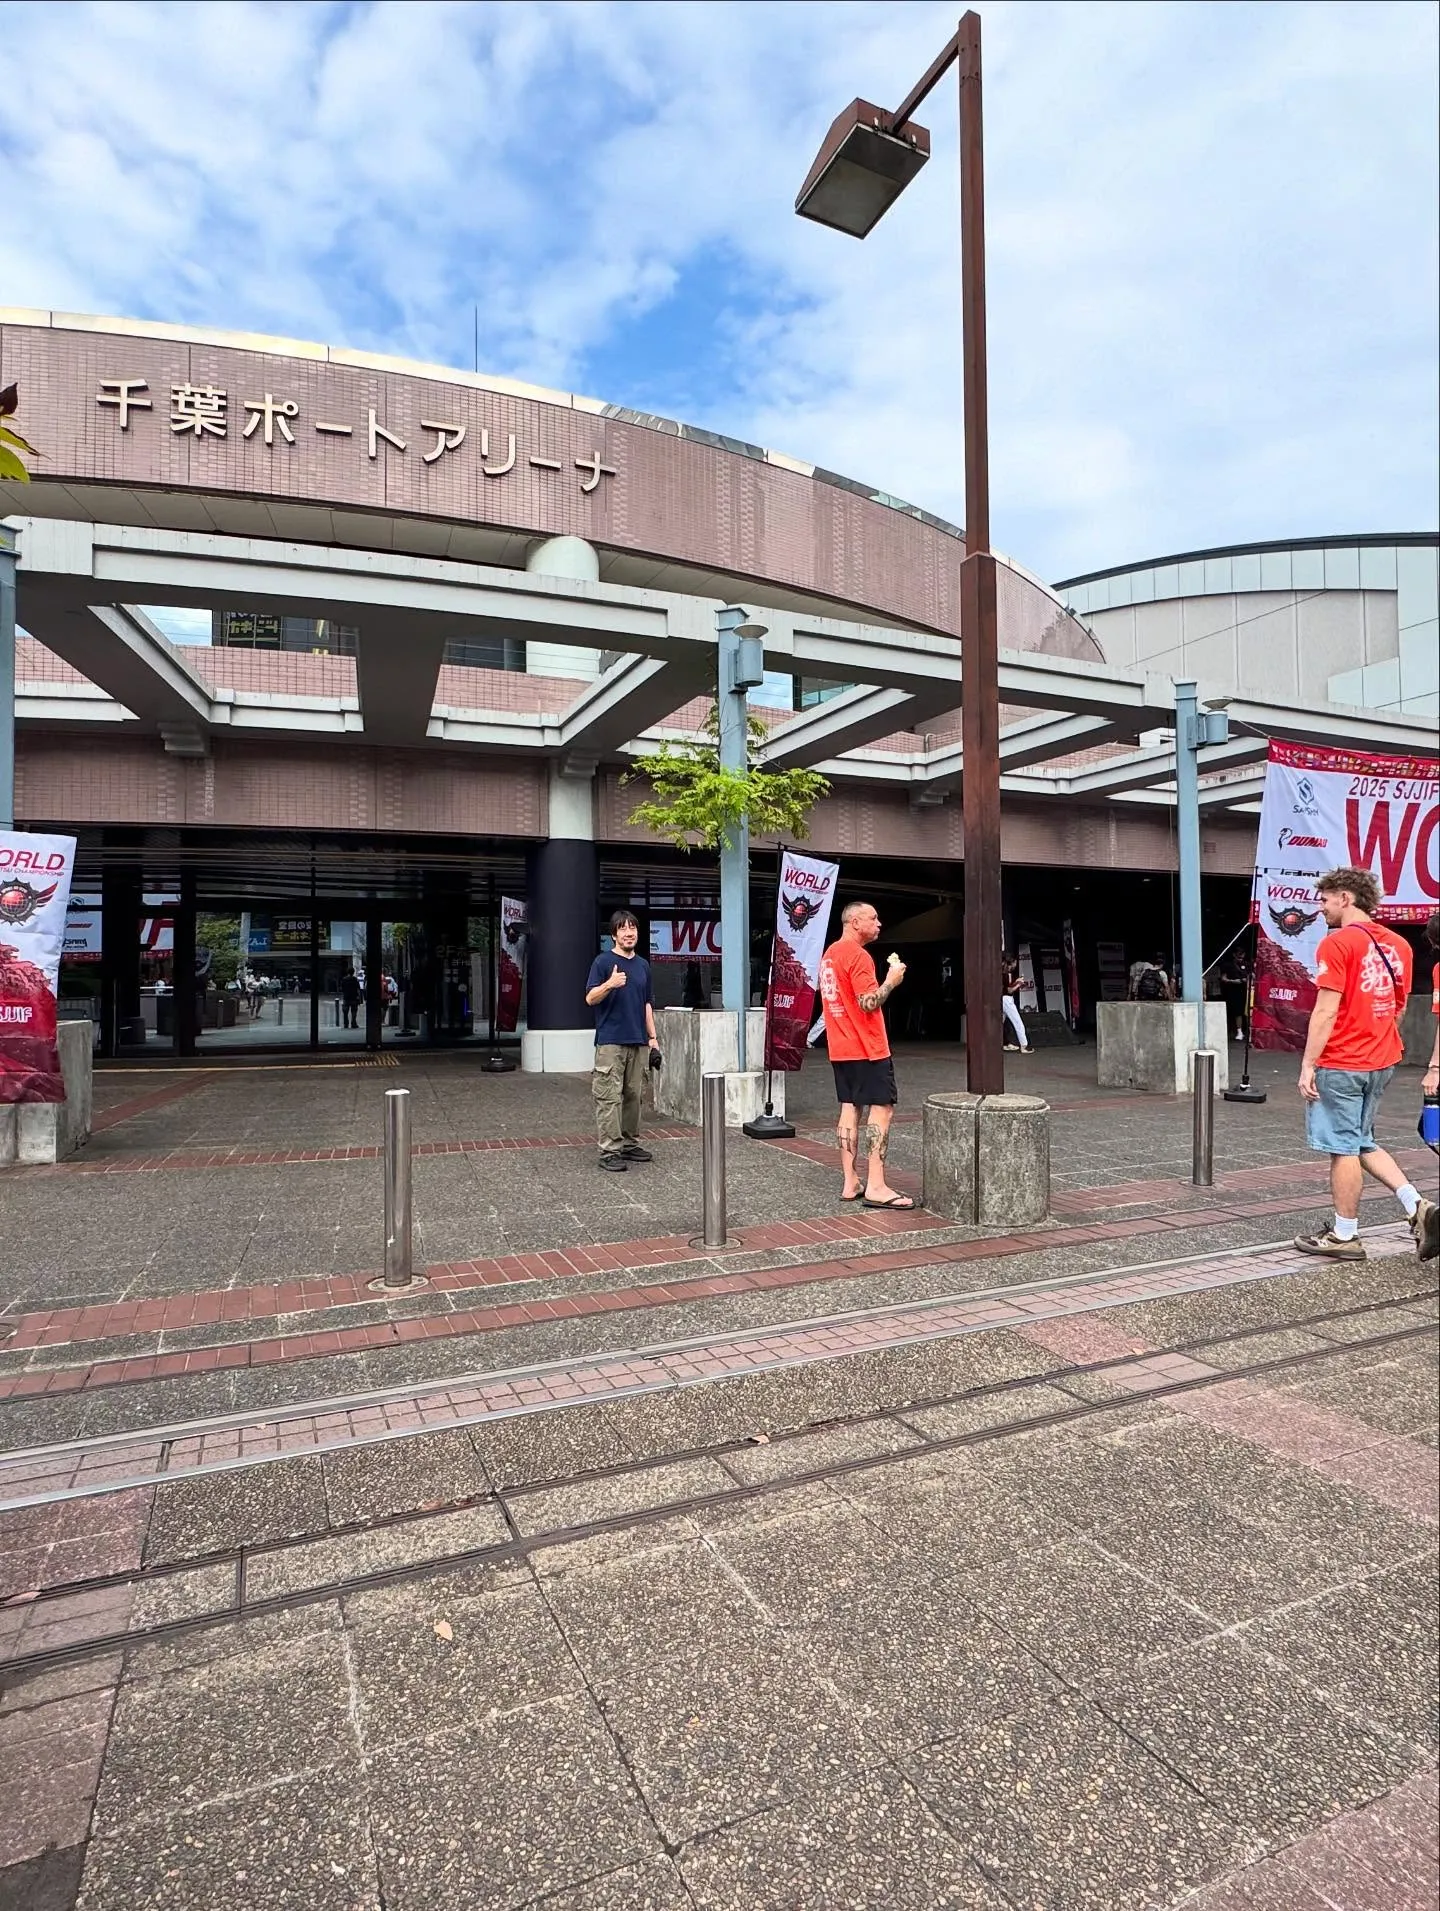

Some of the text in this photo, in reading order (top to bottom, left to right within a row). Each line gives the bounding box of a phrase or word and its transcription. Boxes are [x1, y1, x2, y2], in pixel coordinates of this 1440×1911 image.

[95, 378, 617, 494] 千葉ポートアリーナ
[1348, 776, 1390, 798] 2025
[785, 868, 831, 891] WORLD
